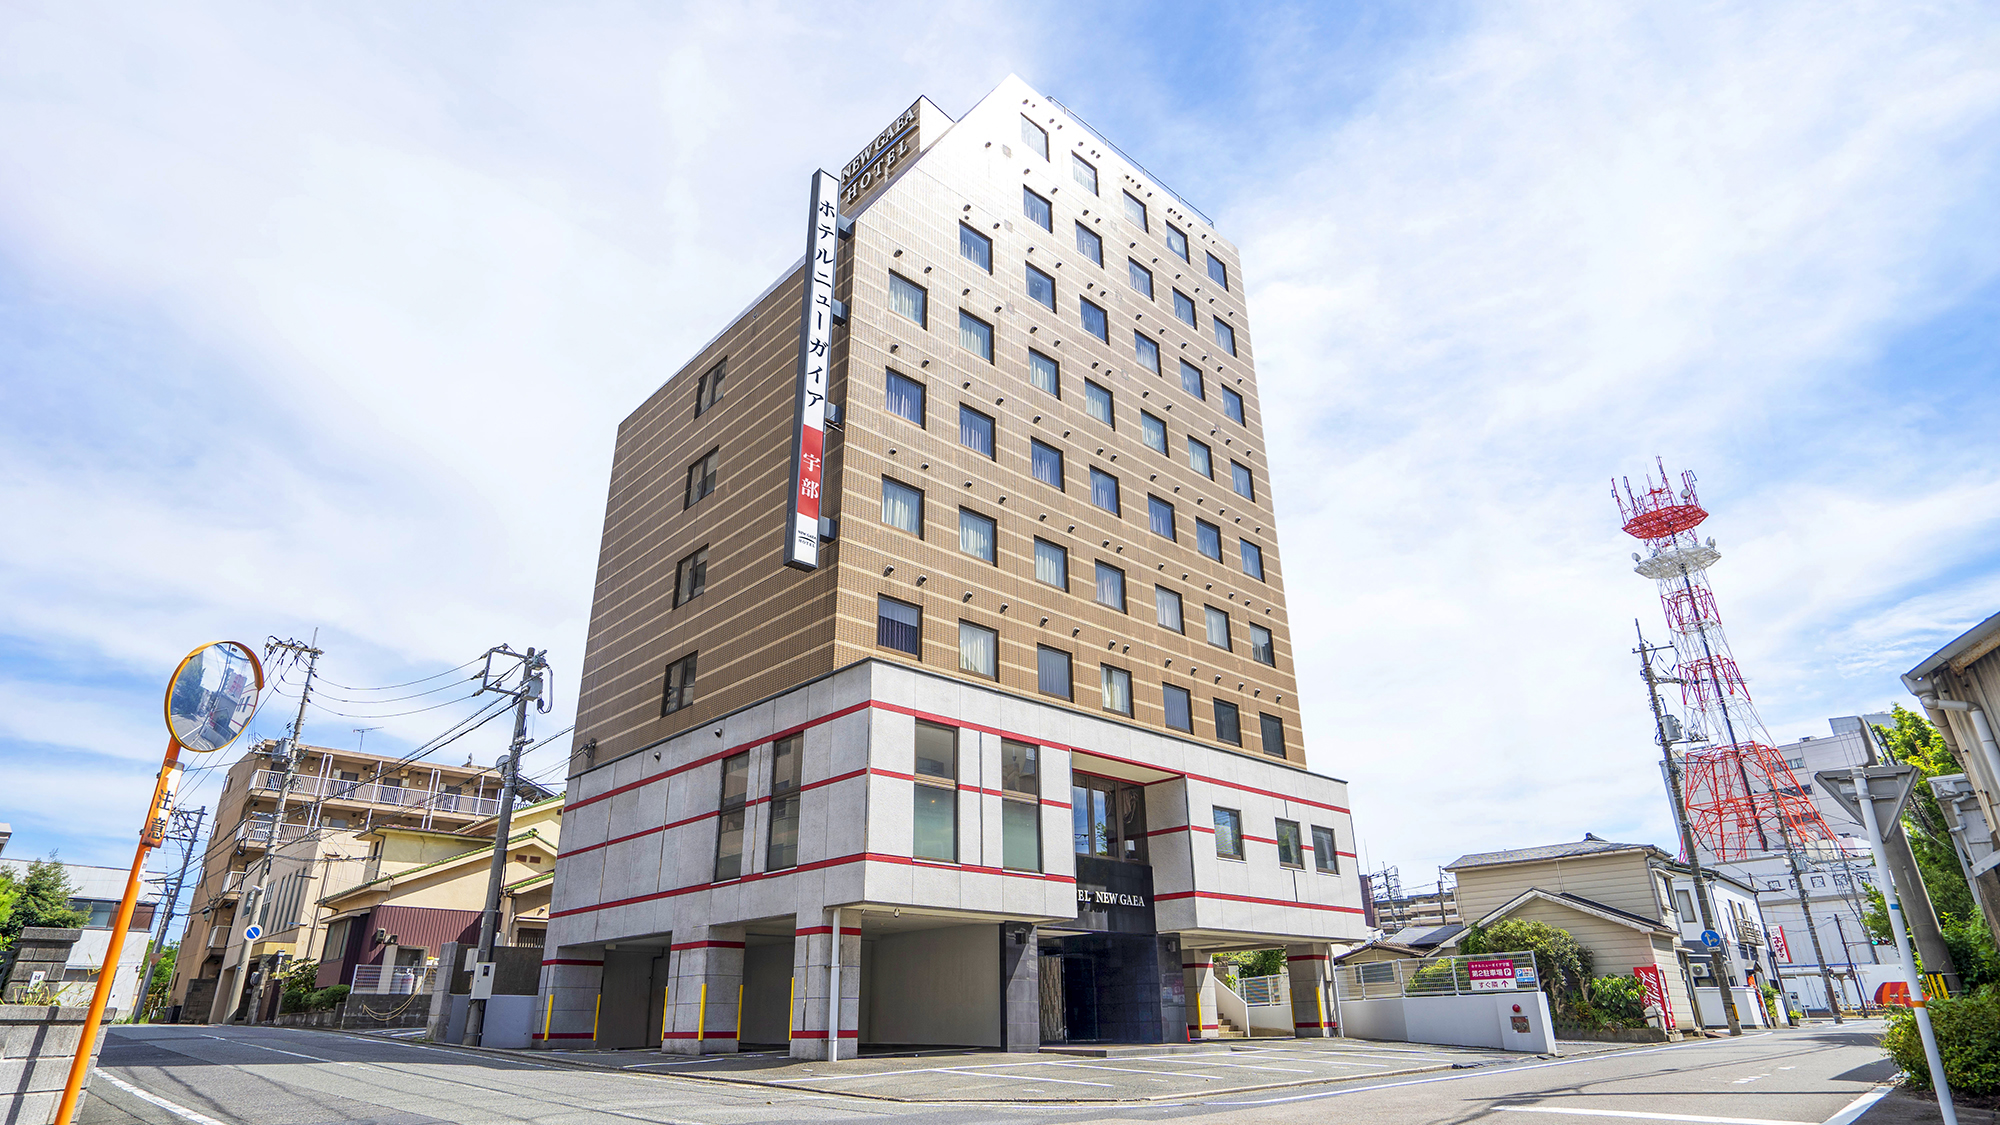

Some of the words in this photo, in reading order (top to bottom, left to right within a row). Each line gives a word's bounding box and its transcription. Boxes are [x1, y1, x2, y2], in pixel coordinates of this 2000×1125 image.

[841, 146, 875, 184] NEW
[875, 108, 915, 151] GAEA
[846, 138, 909, 203] HOTEL
[807, 200, 836, 407] ホテルニューガイア
[801, 453, 821, 499] 宇部
[147, 789, 173, 839] 注意
[1077, 889, 1091, 902] EL
[1096, 891, 1119, 904] NEW
[1119, 894, 1145, 907] GAEA
